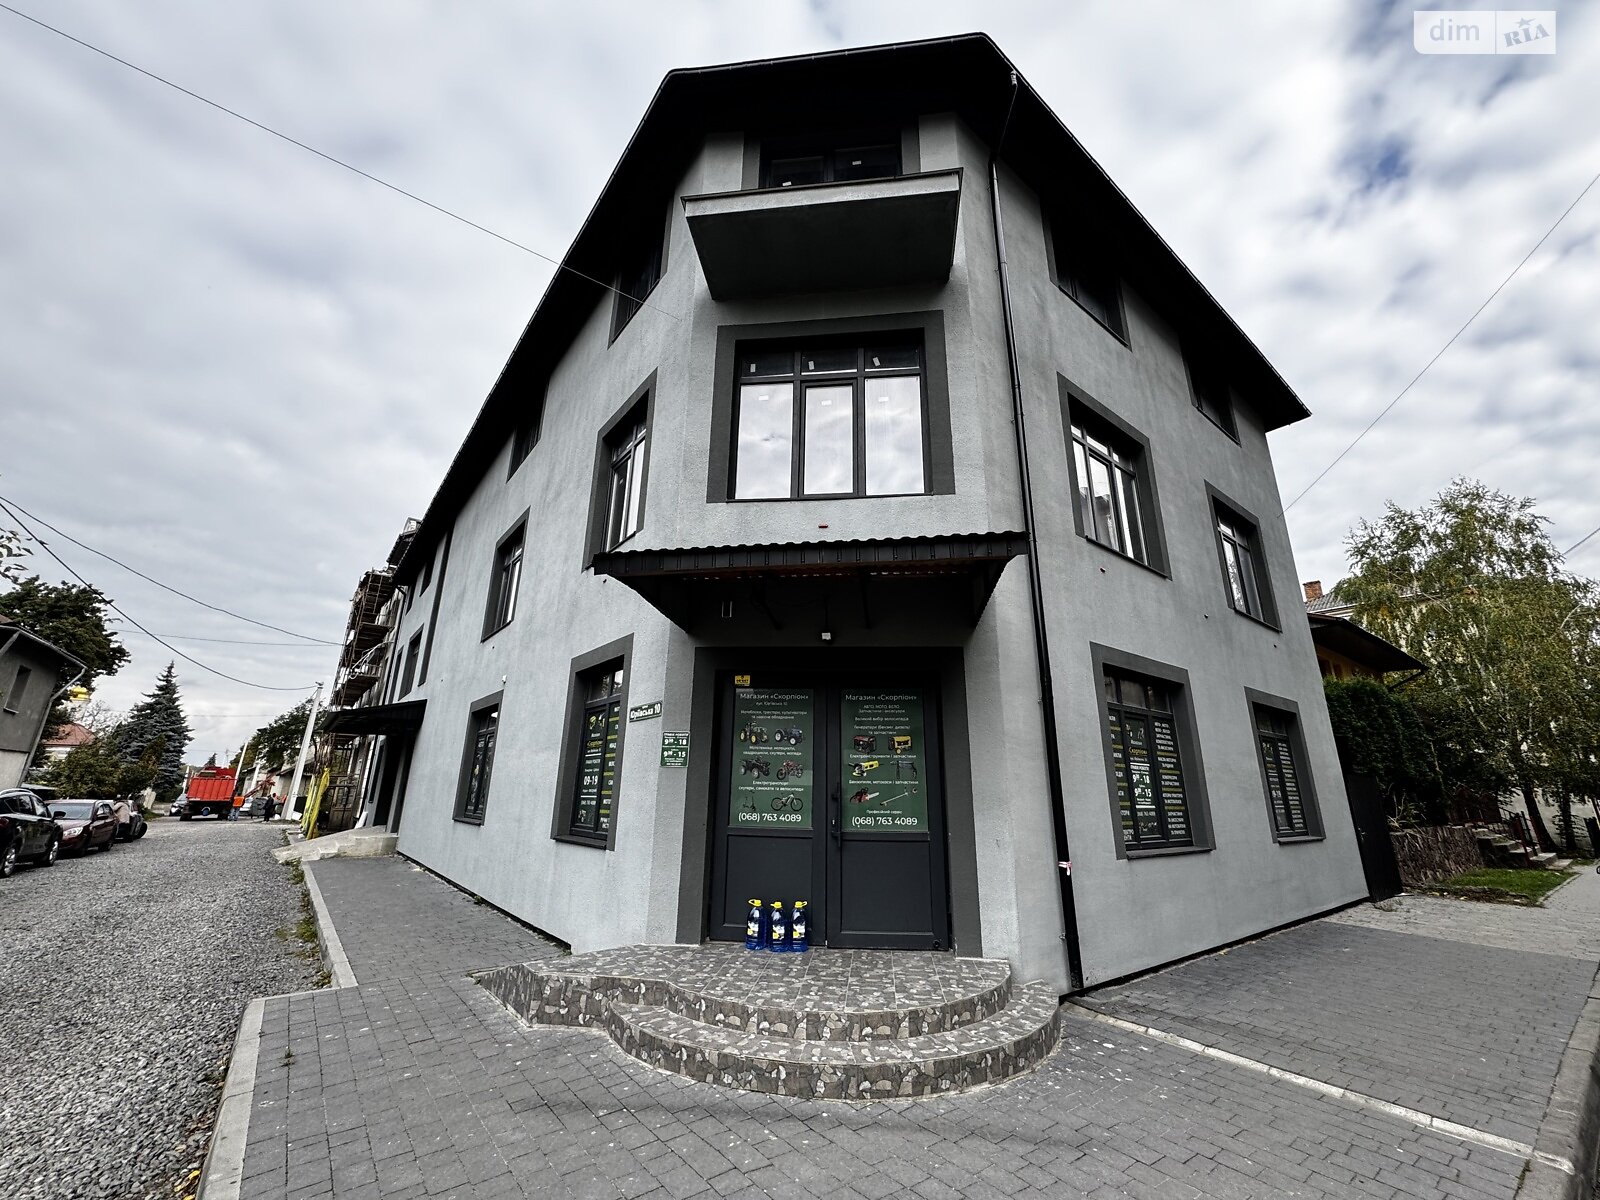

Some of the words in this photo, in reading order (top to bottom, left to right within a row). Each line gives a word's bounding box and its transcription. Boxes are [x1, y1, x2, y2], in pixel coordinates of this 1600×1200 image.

[654, 703, 661, 714] 10
[738, 812, 760, 822] (068)
[762, 813, 778, 821] 763
[779, 814, 802, 822] 4089
[851, 816, 875, 826] (068)
[876, 817, 892, 825] 763
[894, 817, 918, 825] 4089
